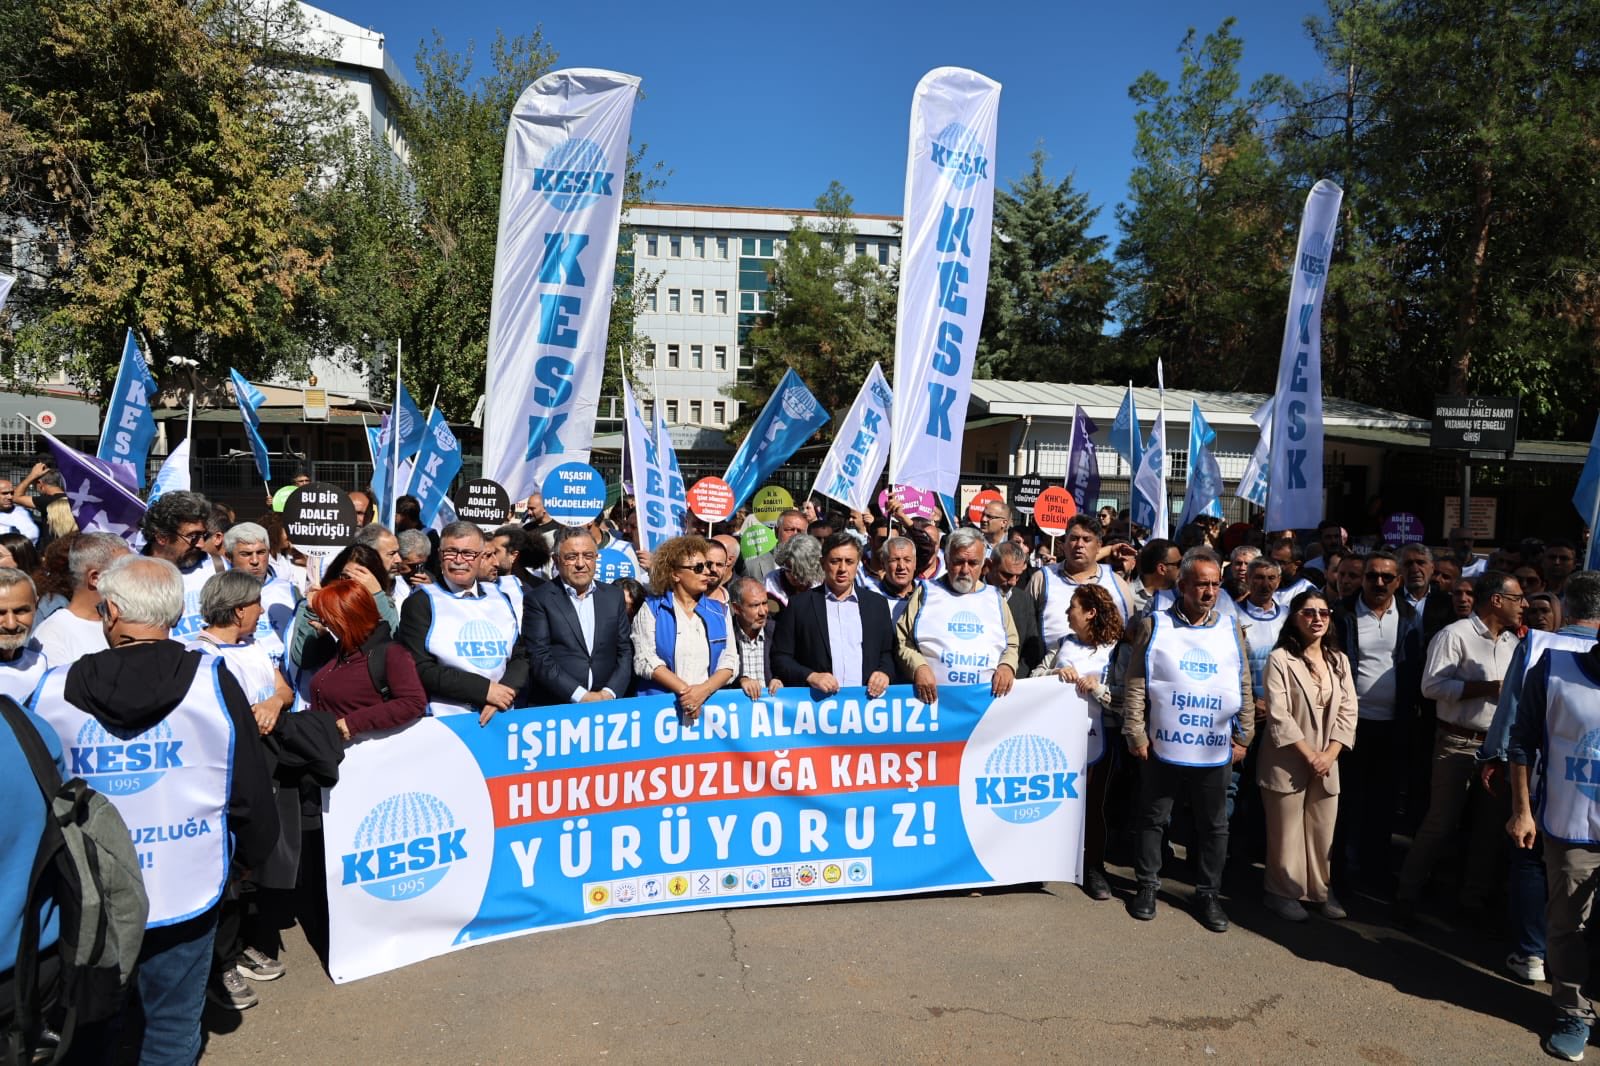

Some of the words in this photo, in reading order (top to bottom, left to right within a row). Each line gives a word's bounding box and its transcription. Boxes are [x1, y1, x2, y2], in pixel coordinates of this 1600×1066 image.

[532, 167, 615, 197] KESK
[926, 201, 974, 441] KESK
[525, 232, 589, 462] KESK
[782, 389, 815, 422] KESK
[1470, 408, 1491, 418] ADALET
[1492, 408, 1514, 419] SARAYI
[1473, 420, 1481, 430] VE
[1482, 420, 1506, 431] ENGELLİ
[828, 407, 881, 501] KESK
[559, 470, 593, 482] YAŞASIN
[301, 492, 317, 503] BU
[318, 490, 338, 504] BİR
[469, 485, 481, 494] BU
[482, 484, 497, 495] BİR
[563, 485, 587, 495] EMEK
[468, 497, 497, 506] ADALET
[544, 496, 604, 509] MÜCADELEMİZ!
[1044, 495, 1068, 504] KHK'ler
[299, 508, 339, 520] ADALET
[1047, 503, 1064, 514] İPTAL
[947, 622, 985, 634] KESK
[454, 640, 509, 657] KESK
[940, 649, 990, 669] İŞİMİZİ
[1180, 660, 1219, 674] KESK
[947, 669, 981, 685] GERİ
[1171, 690, 1223, 711] İŞİMİZİ
[1178, 713, 1214, 729] GERİ
[507, 710, 641, 771] İŞİMİZİ
[653, 700, 740, 745] GERİ
[1155, 728, 1227, 747] ALACAĞIZ!
[70, 740, 184, 775] KESK
[106, 776, 142, 793] 1995
[508, 749, 818, 820] HUKUKSUZLUĞA
[830, 750, 938, 793] KARŞI
[975, 771, 1079, 805] KESK
[1012, 806, 1042, 821] 1995
[509, 800, 937, 889] YÜRÜYORUZ!
[341, 827, 468, 887] KESK
[389, 876, 426, 897] 1995
[771, 876, 792, 889] BTS
